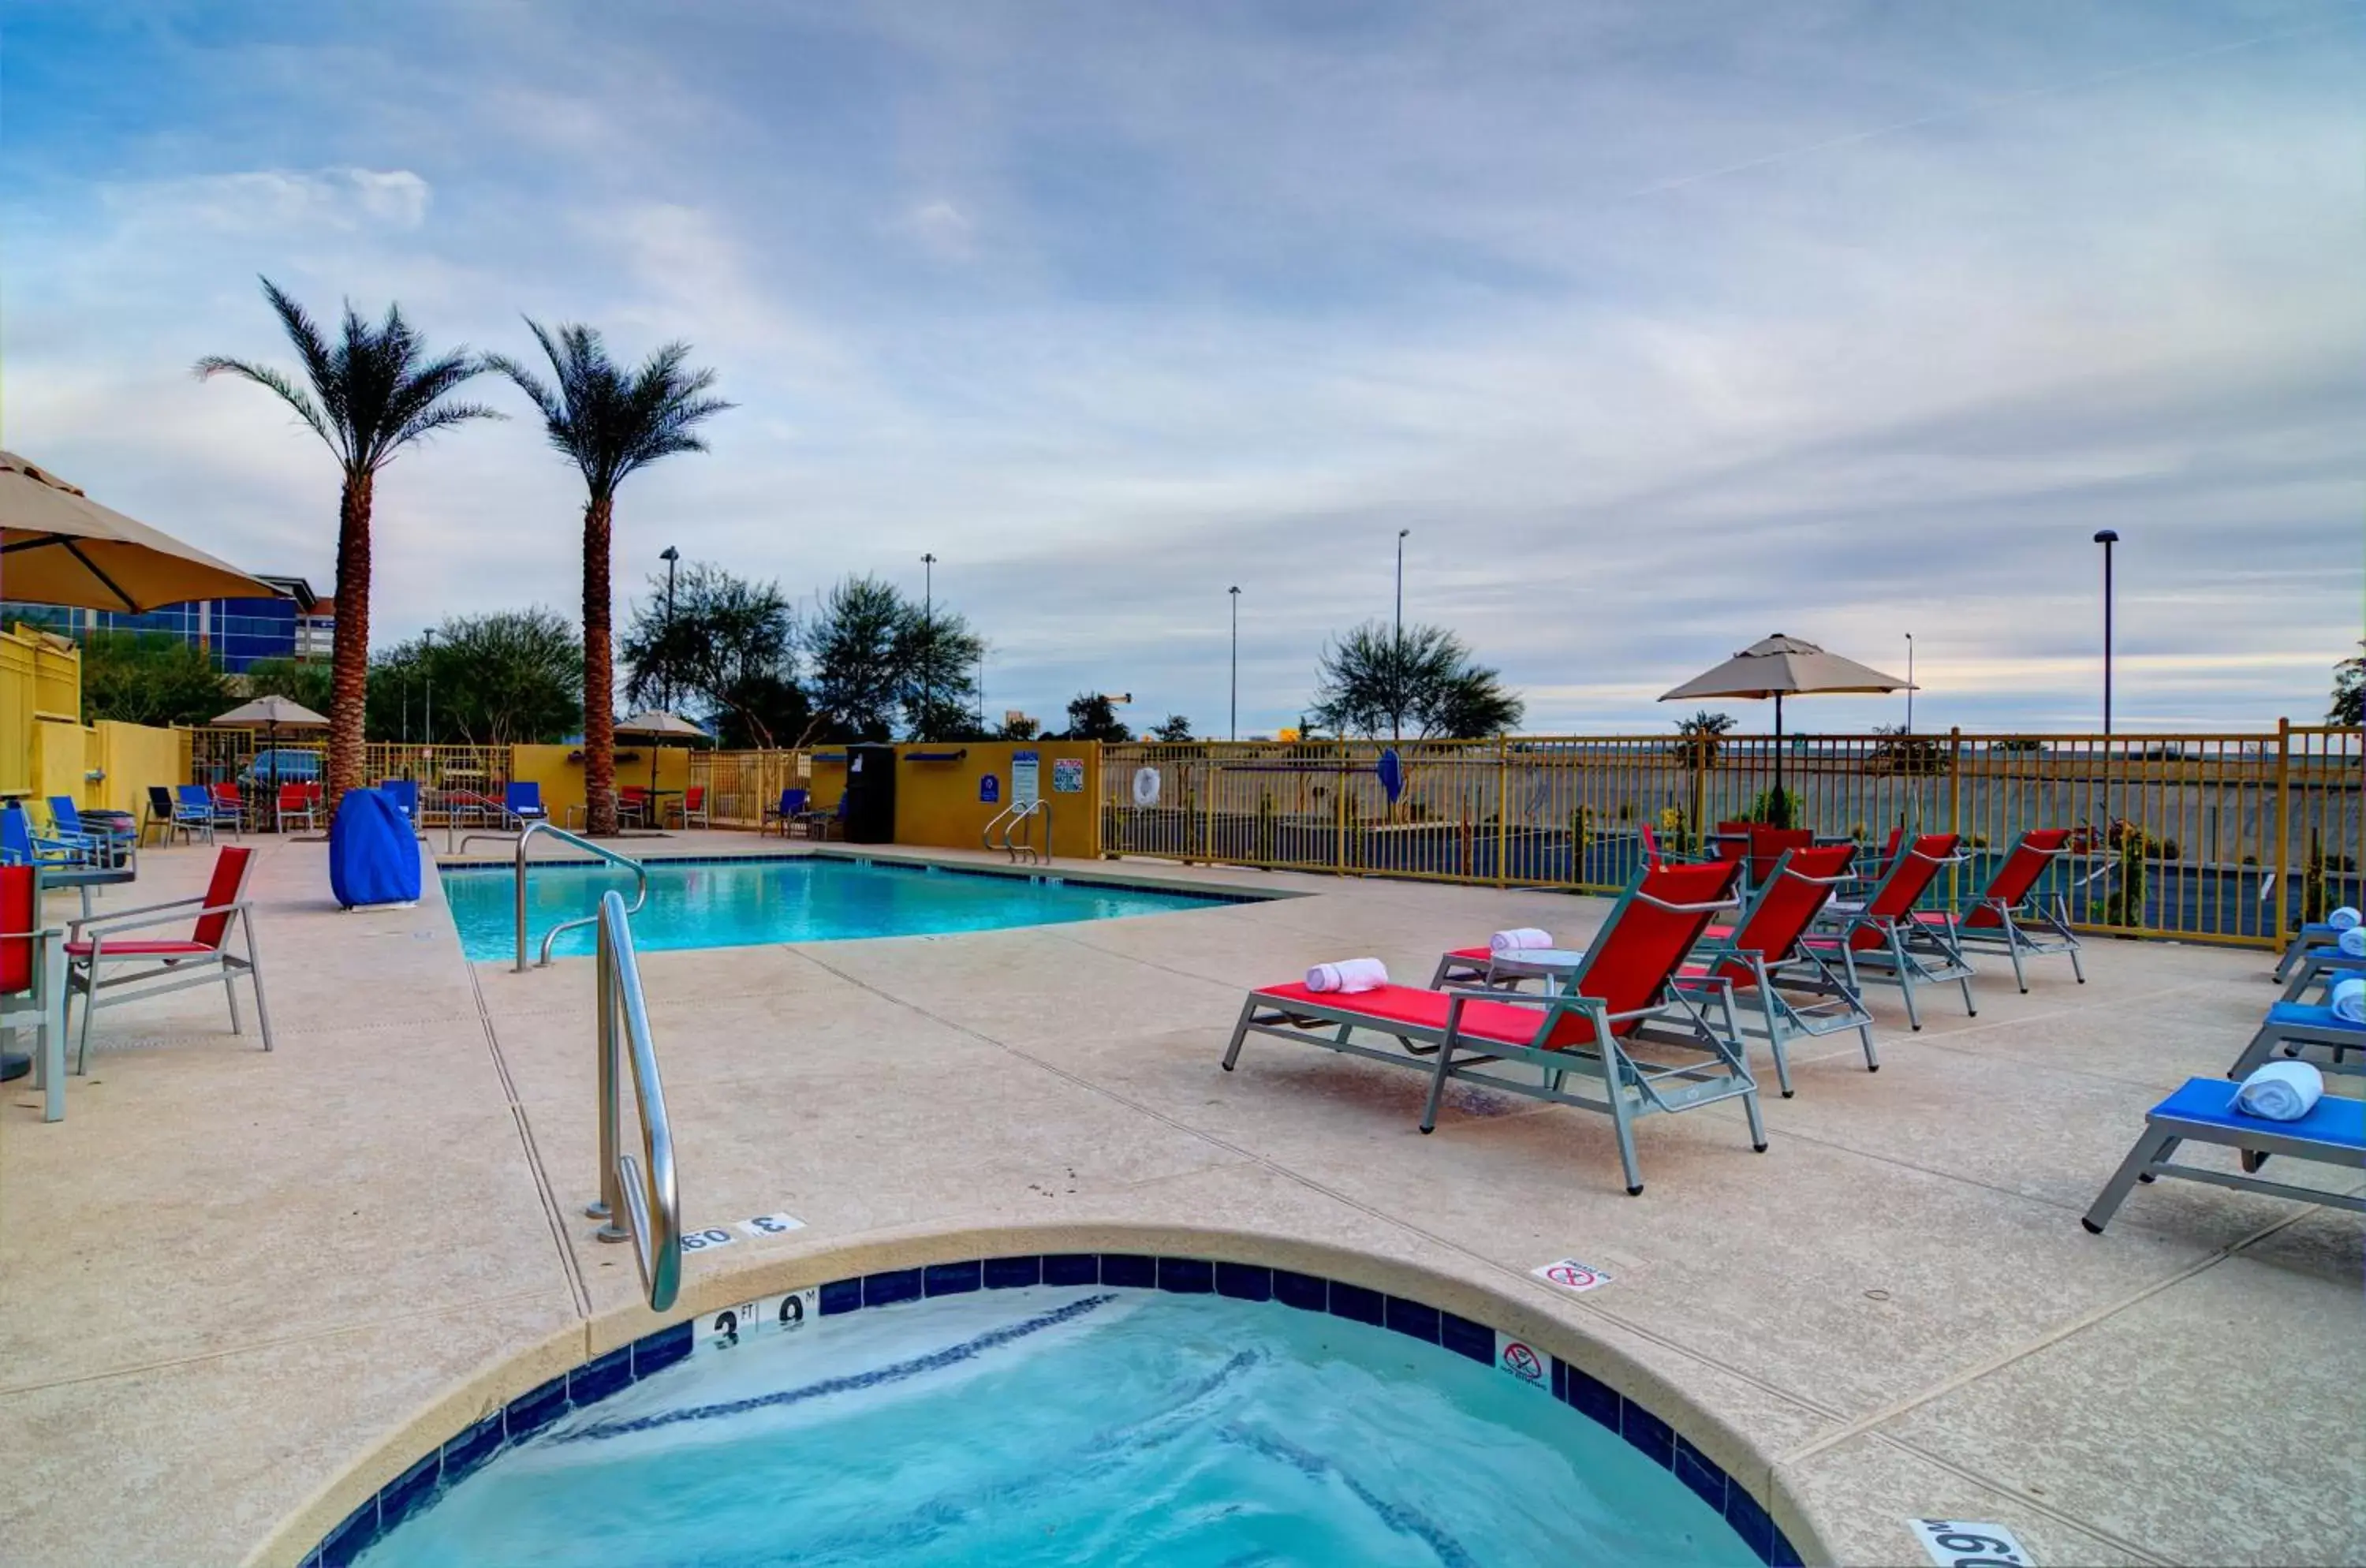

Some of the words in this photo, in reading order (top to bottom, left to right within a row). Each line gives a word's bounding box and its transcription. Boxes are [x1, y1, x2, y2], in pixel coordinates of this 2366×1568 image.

[752, 1217, 786, 1233] 3
[714, 1310, 739, 1350] 3
[741, 1304, 753, 1320] FT
[806, 1290, 815, 1302] M
